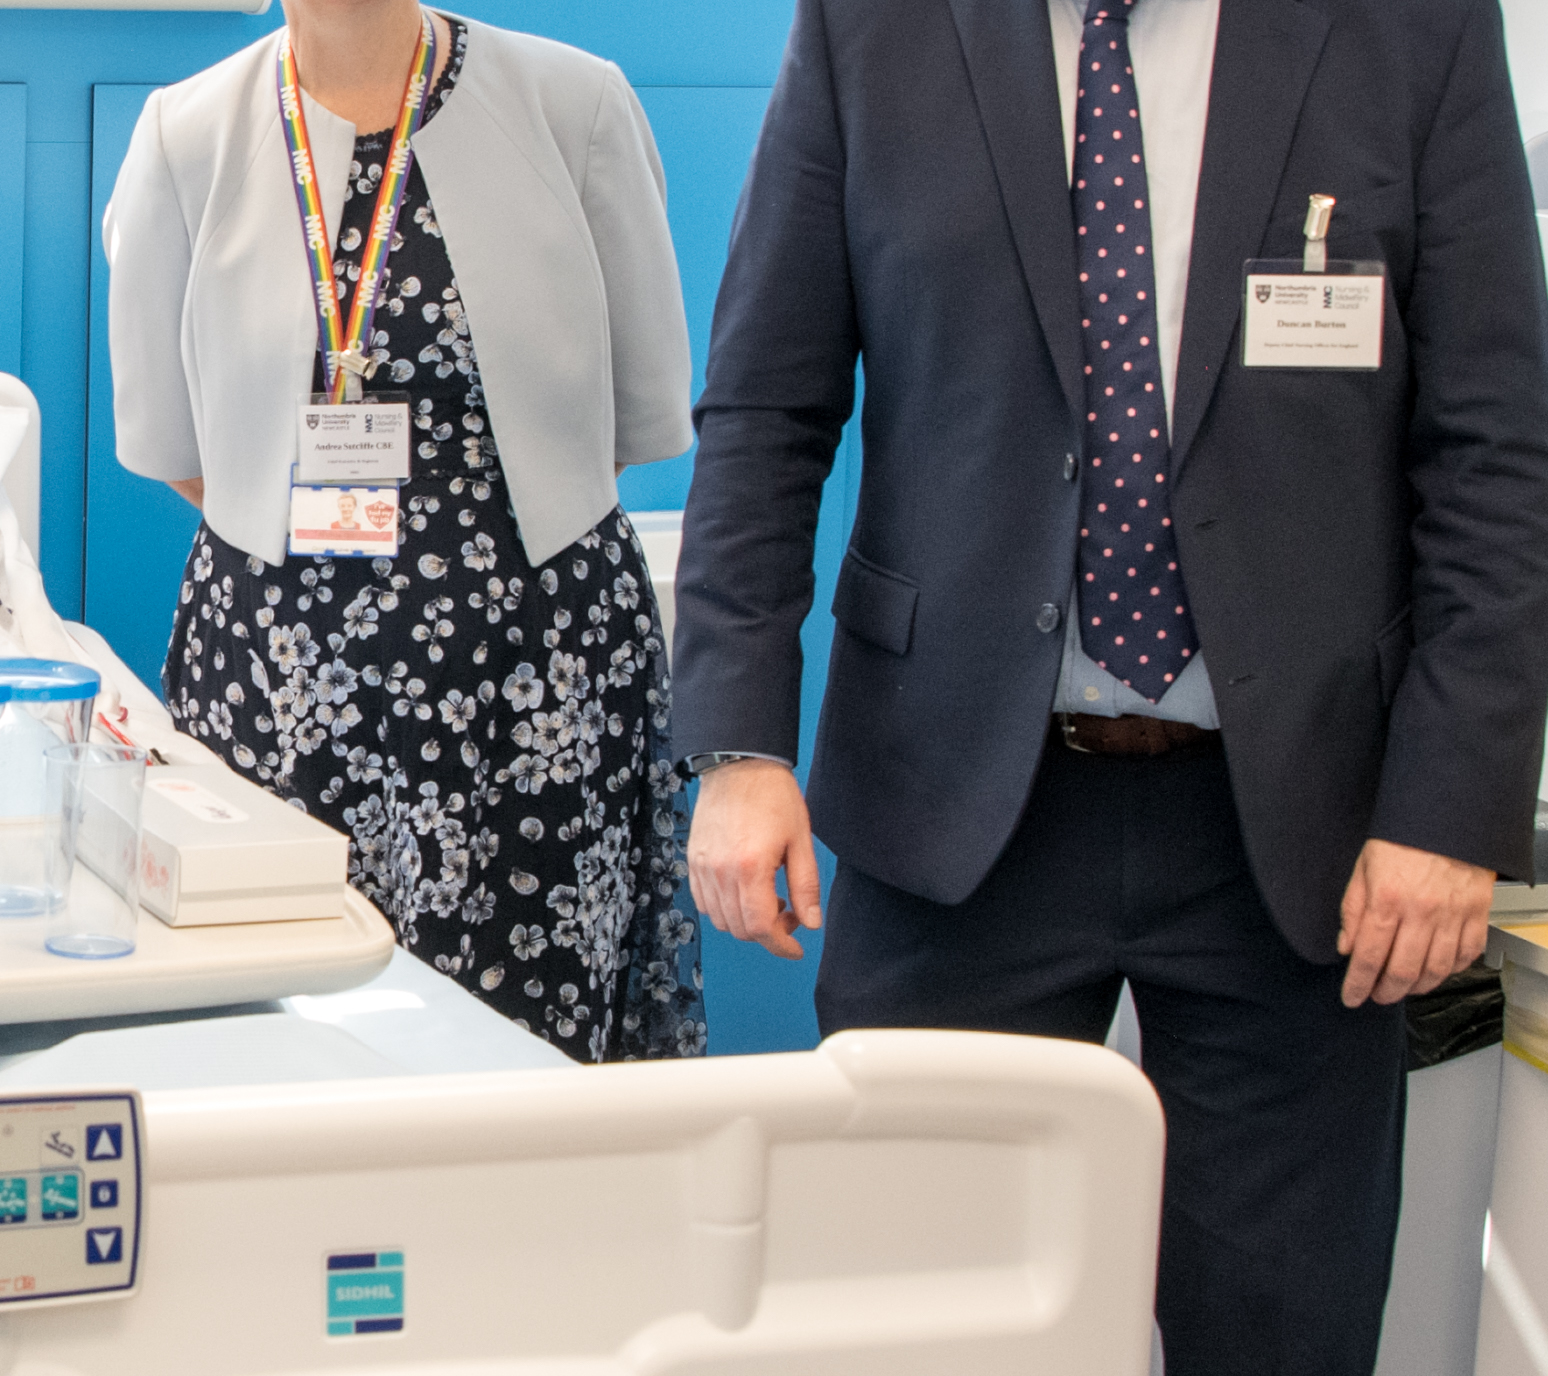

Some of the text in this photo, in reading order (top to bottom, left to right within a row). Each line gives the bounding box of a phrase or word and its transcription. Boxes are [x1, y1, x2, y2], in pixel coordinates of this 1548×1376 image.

[280, 85, 300, 120] NMC
[405, 73, 427, 109] NMC
[292, 148, 312, 185] NMC
[390, 138, 411, 174] NMC
[305, 214, 325, 250] NMC
[373, 204, 395, 241] NMC
[316, 280, 336, 317] NMC
[357, 270, 379, 307] NMC
[1277, 320, 1346, 329] Duncan Burton
[314, 443, 341, 451] Andrea
[376, 442, 394, 450] CBE
[335, 1284, 395, 1301] SIDHIL
